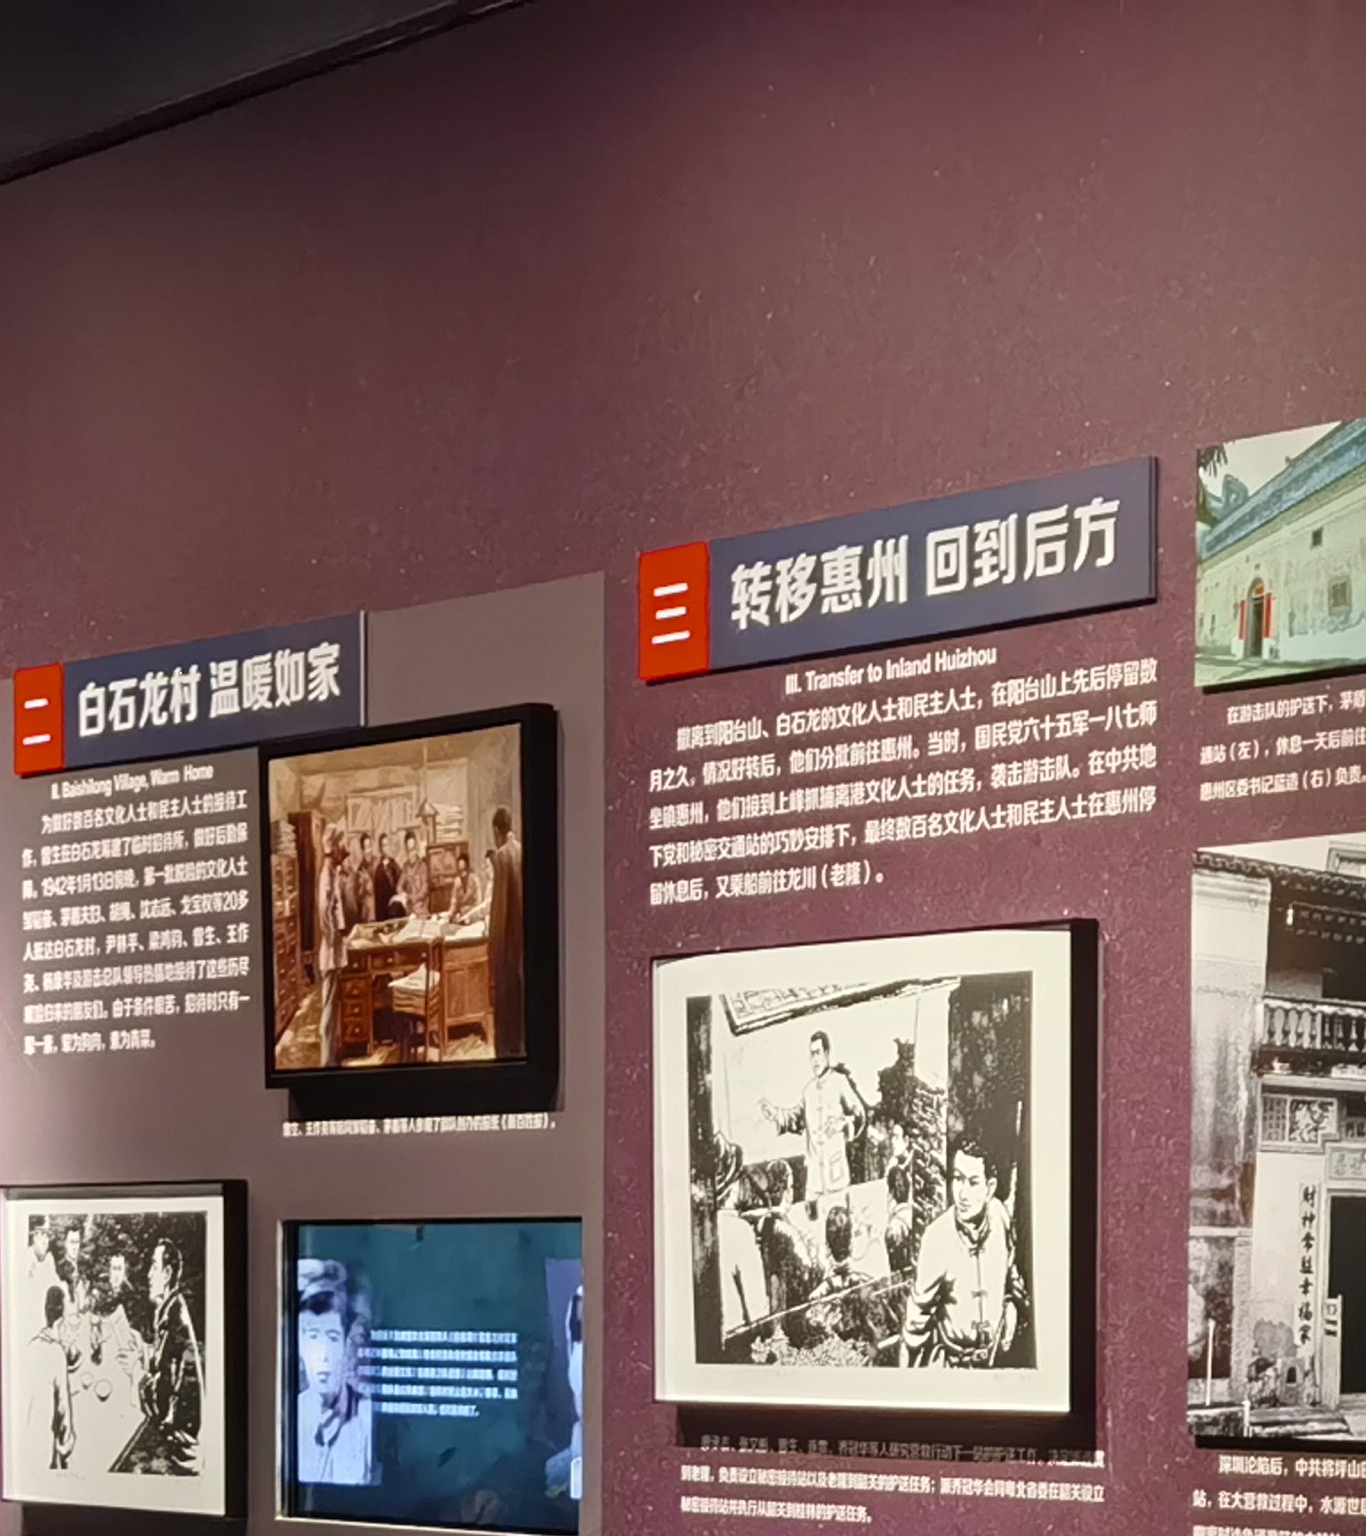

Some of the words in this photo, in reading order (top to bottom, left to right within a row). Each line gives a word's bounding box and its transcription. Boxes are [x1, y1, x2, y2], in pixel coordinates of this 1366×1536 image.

[731, 535, 909, 630] 转移惠州
[925, 497, 1121, 597] 回到后方
[78, 664, 201, 738] 白石龙村
[209, 641, 342, 720] 温暖如家
[806, 664, 864, 692] Transfer
[867, 662, 883, 683] to
[886, 653, 931, 680] Inland
[935, 647, 997, 673] Huizhou
[183, 763, 214, 782] Home
